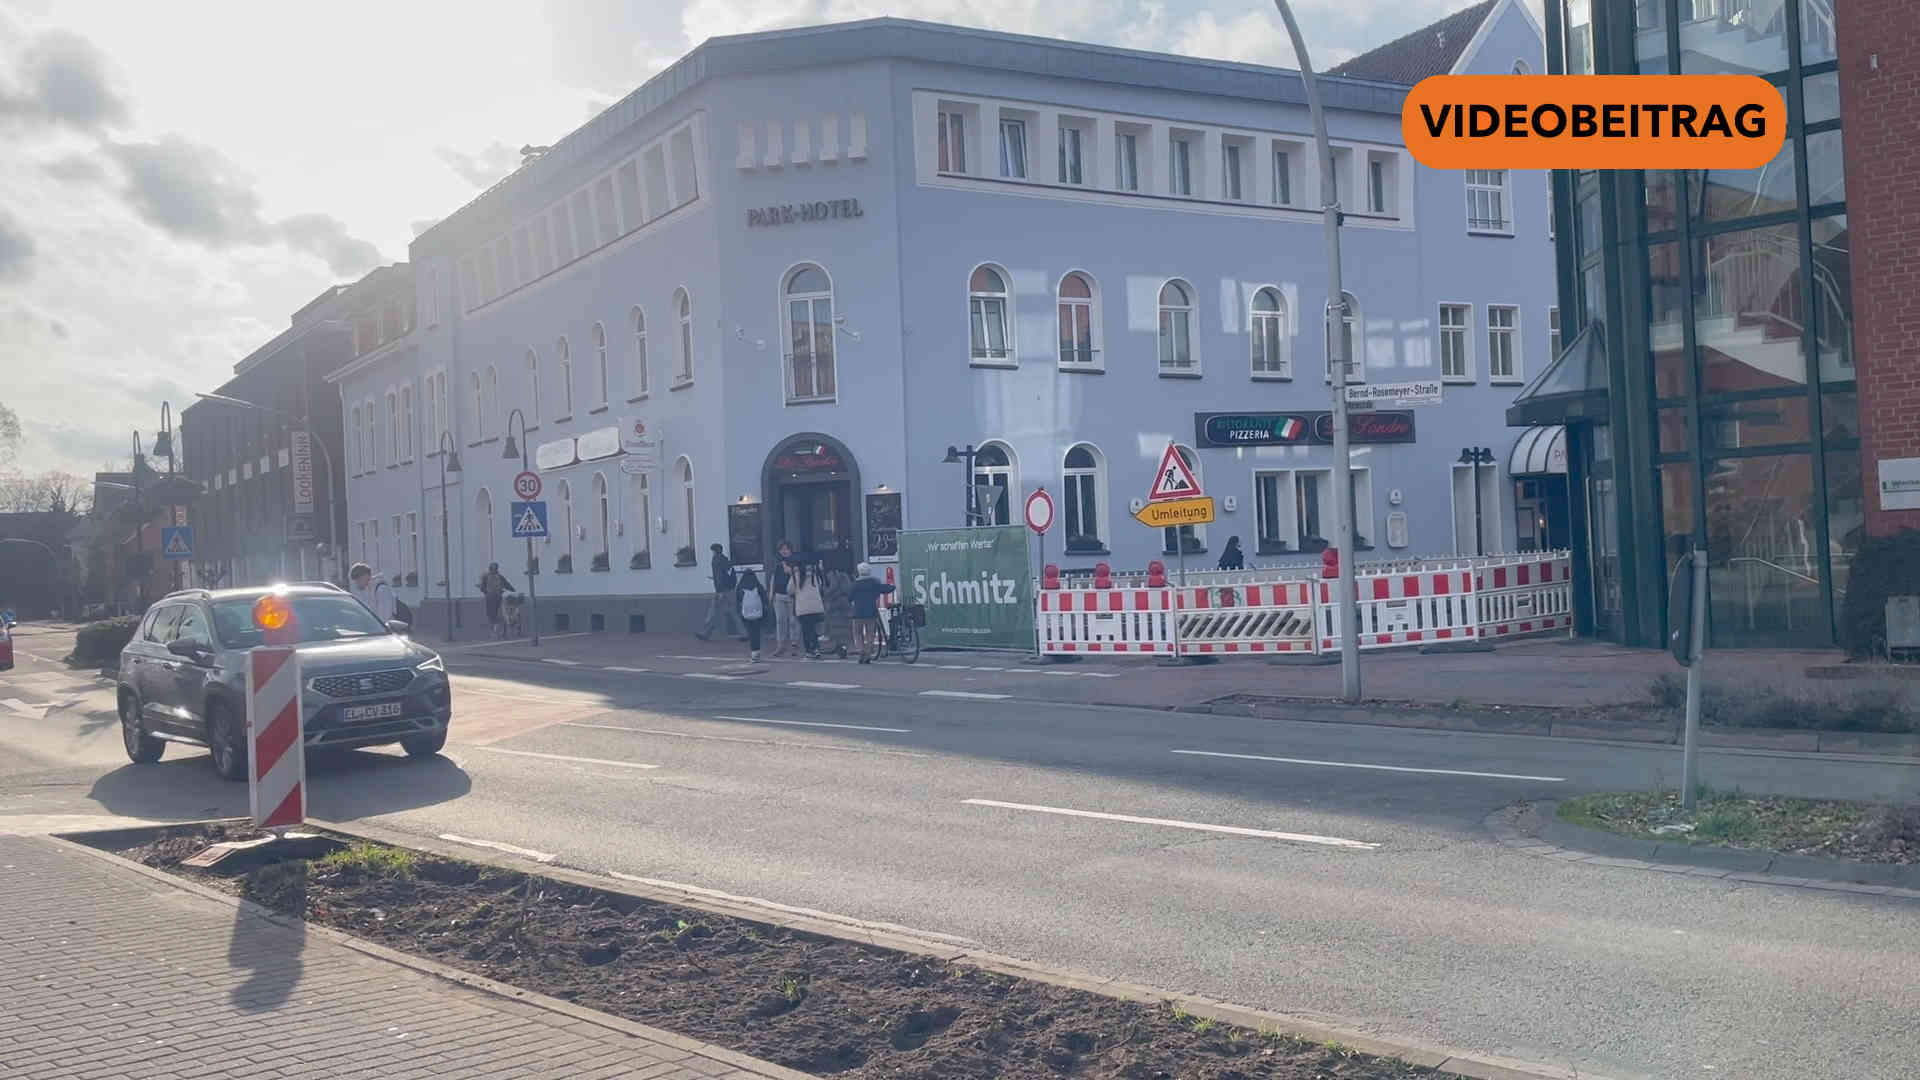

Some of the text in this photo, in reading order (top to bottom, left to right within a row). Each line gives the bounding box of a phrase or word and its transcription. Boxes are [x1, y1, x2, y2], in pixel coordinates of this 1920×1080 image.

[747, 198, 863, 228] PARK-HOTEL
[1229, 430, 1270, 441] PIZZERIA
[519, 480, 537, 492] 30
[1151, 507, 1208, 520] Umleitung
[913, 570, 1017, 605] Schmitz
